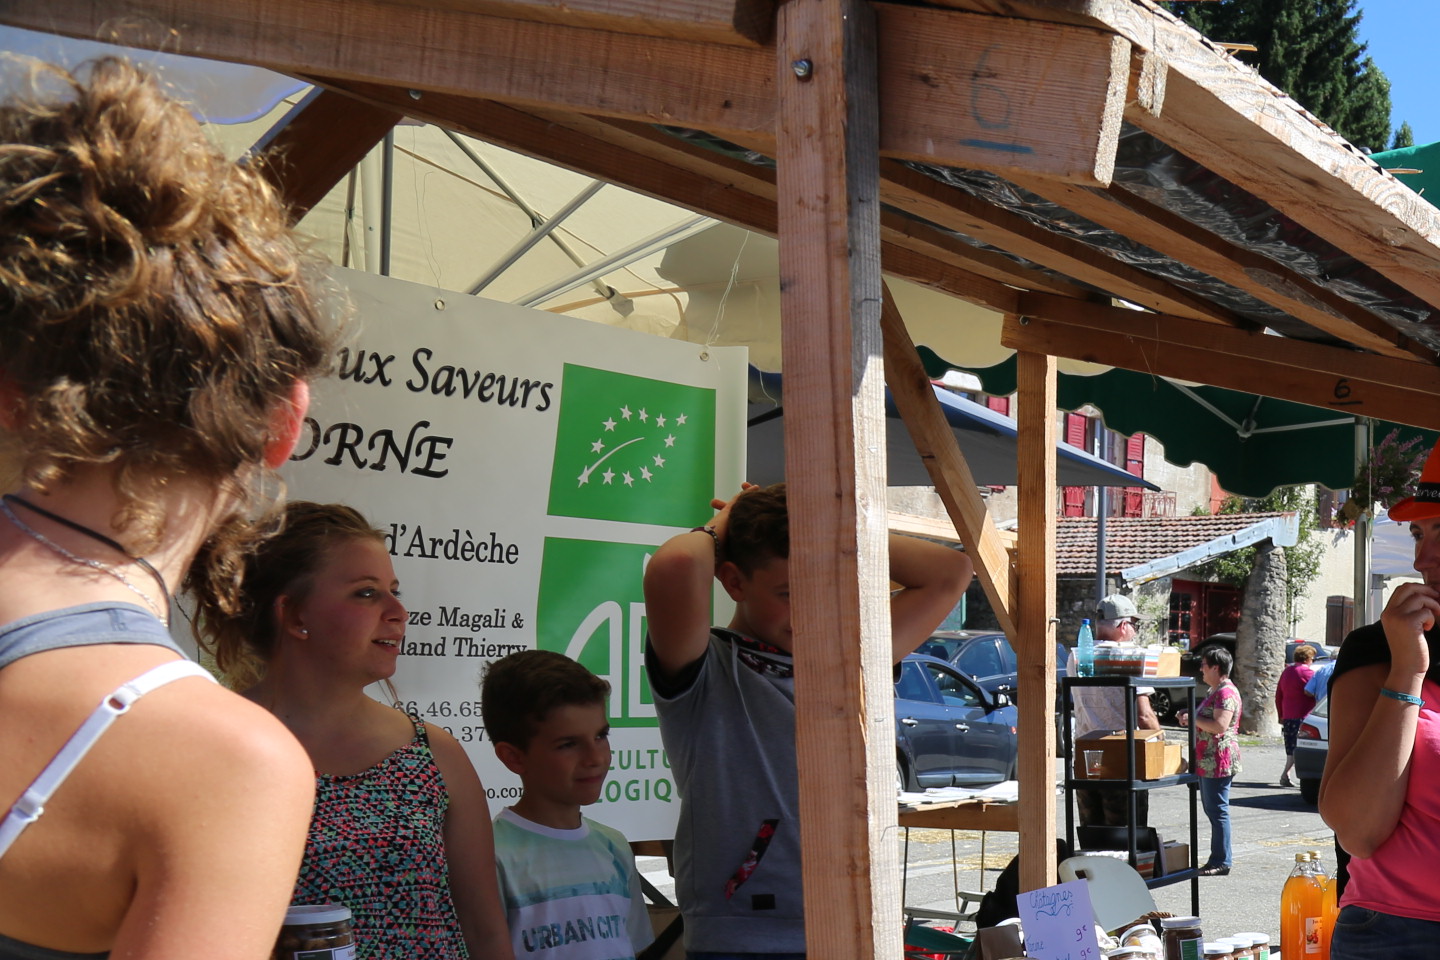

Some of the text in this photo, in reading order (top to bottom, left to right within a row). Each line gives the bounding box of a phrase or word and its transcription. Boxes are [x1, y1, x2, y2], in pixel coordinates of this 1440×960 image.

[330, 346, 554, 412] ux Saveurs
[1334, 377, 1352, 399] 6
[384, 523, 520, 565] d'Ardèche
[407, 606, 525, 632] ze Magali &
[453, 636, 528, 658] Thierry
[596, 778, 673, 804] OGIQ
[521, 914, 627, 953] URBAN CIT
